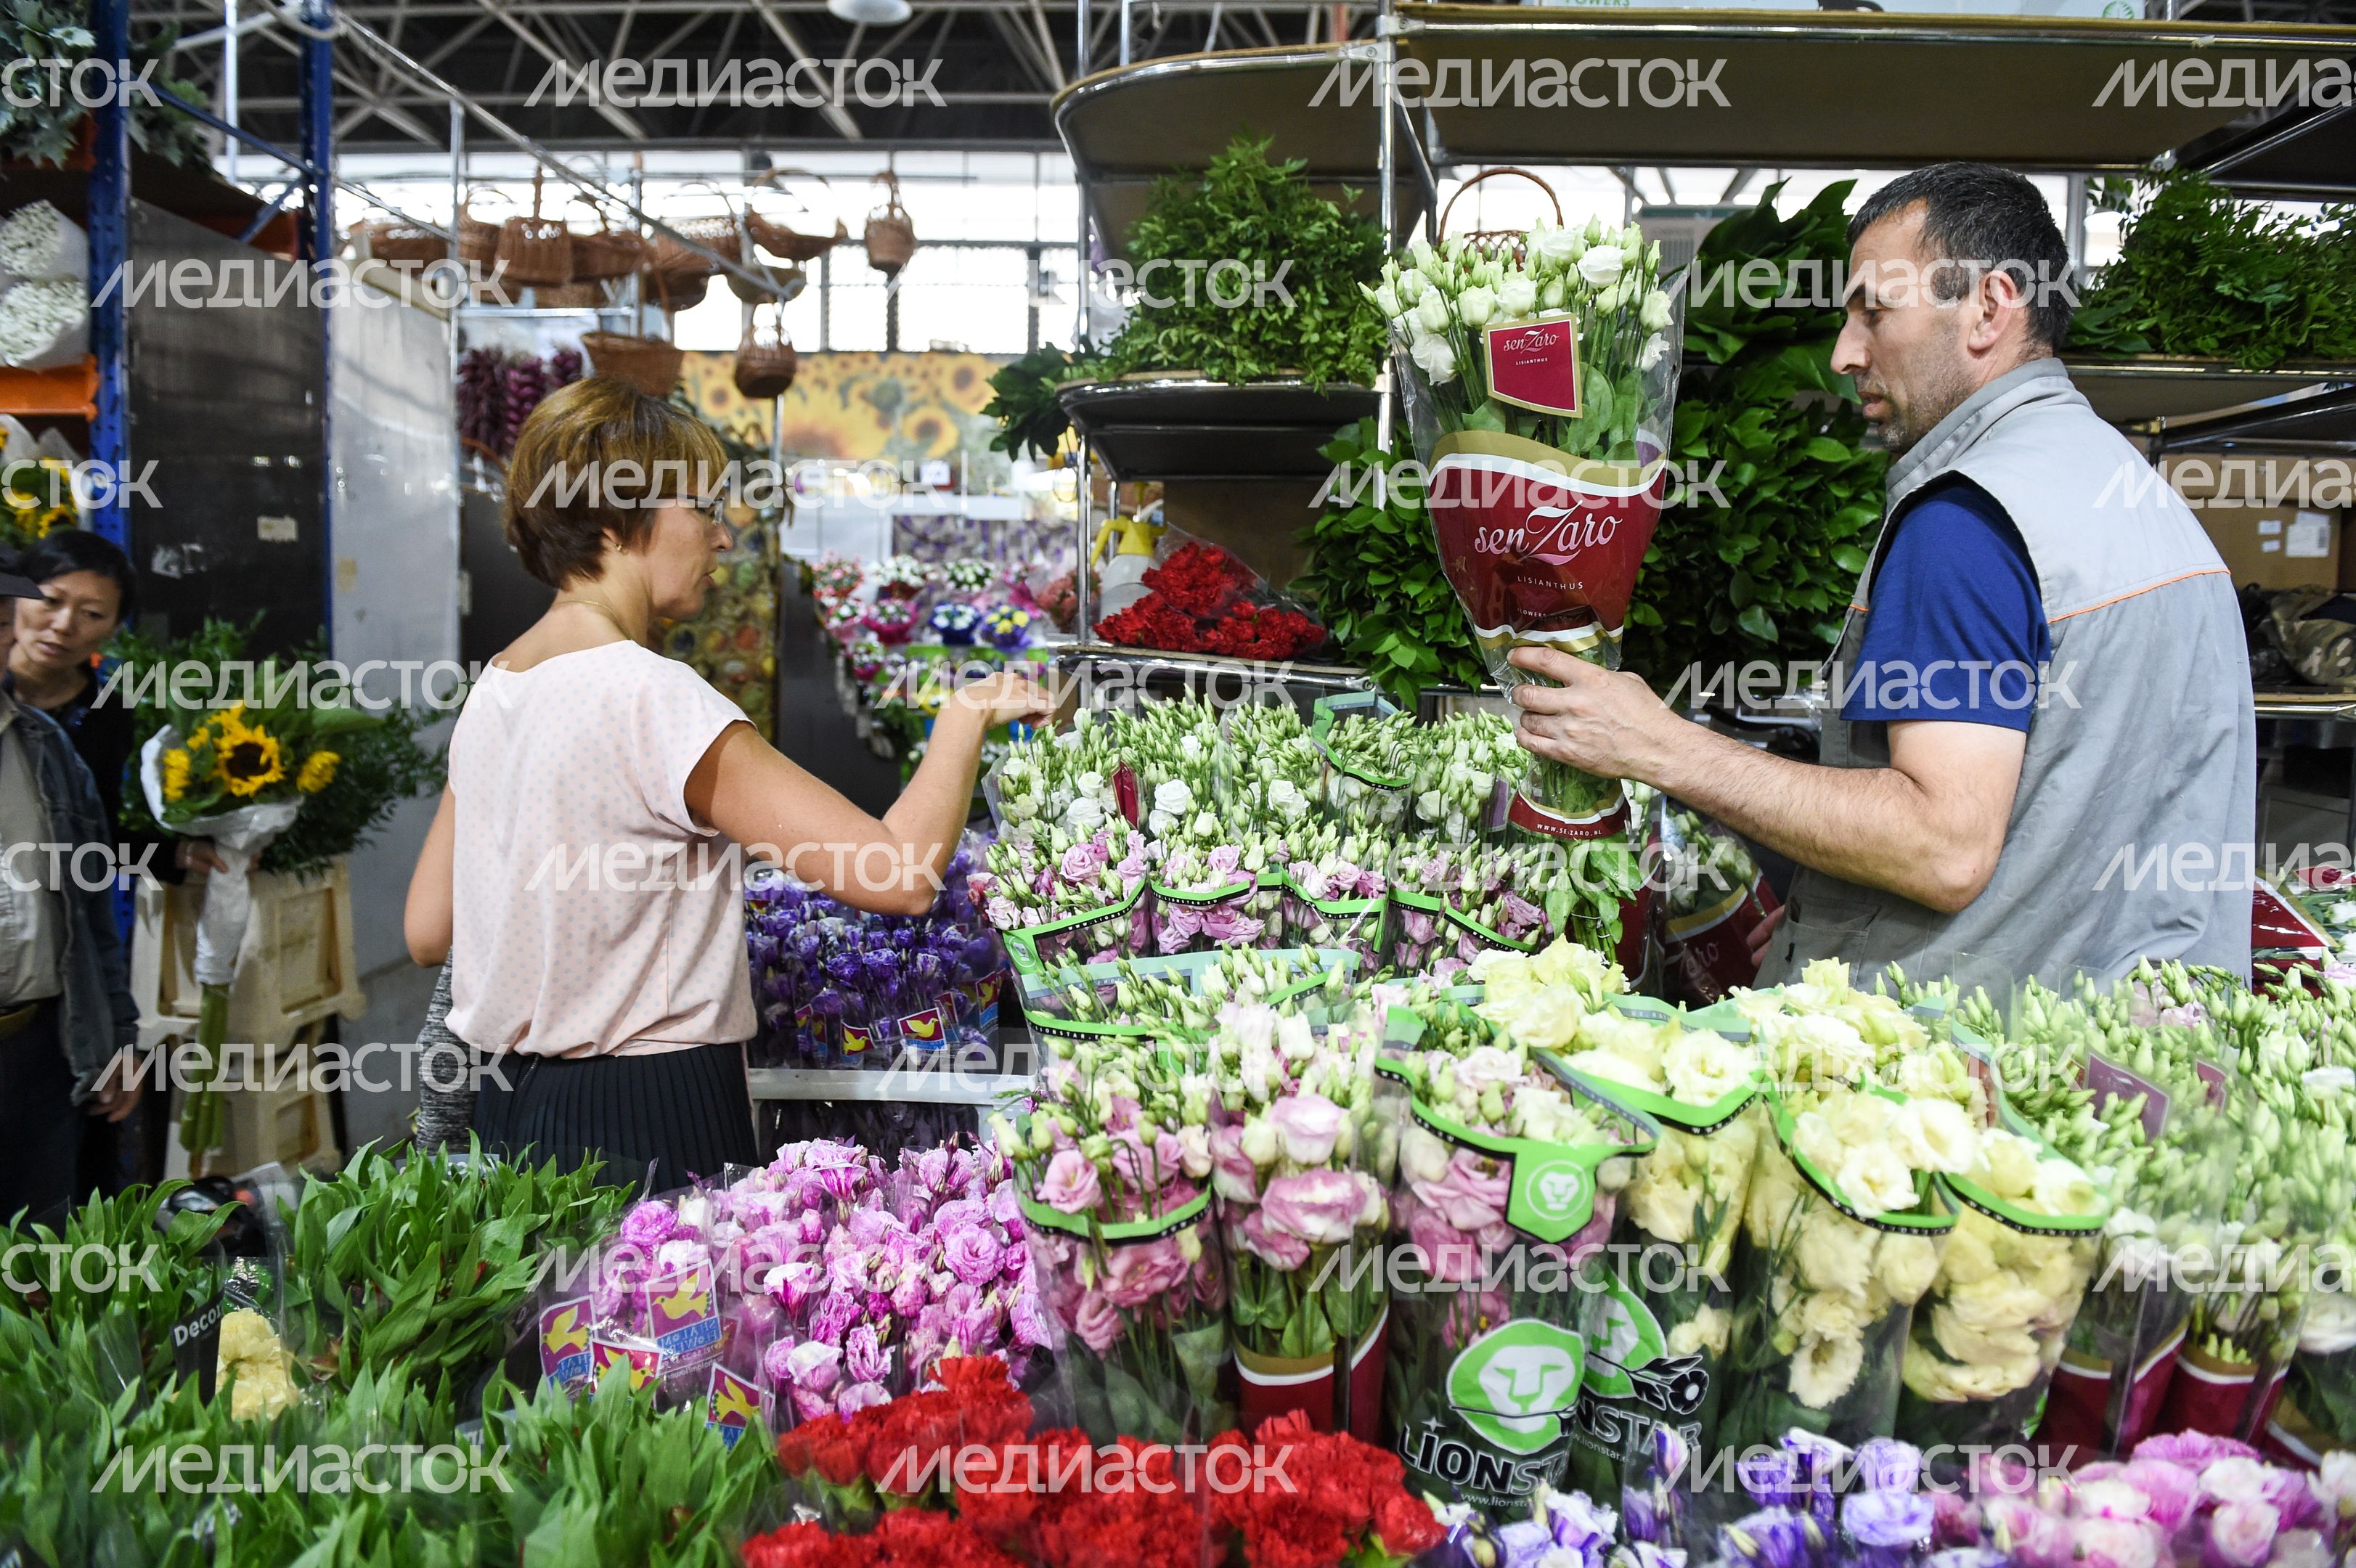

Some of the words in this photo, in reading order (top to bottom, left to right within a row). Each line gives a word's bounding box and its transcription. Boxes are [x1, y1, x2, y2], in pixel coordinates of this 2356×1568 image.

[1515, 357, 1548, 366] LISIANTHUS
[1474, 499, 1623, 565] senZaro
[1517, 576, 1584, 590] LISIANTHUS
[1536, 823, 1602, 836] WWW.SEZARO.NL
